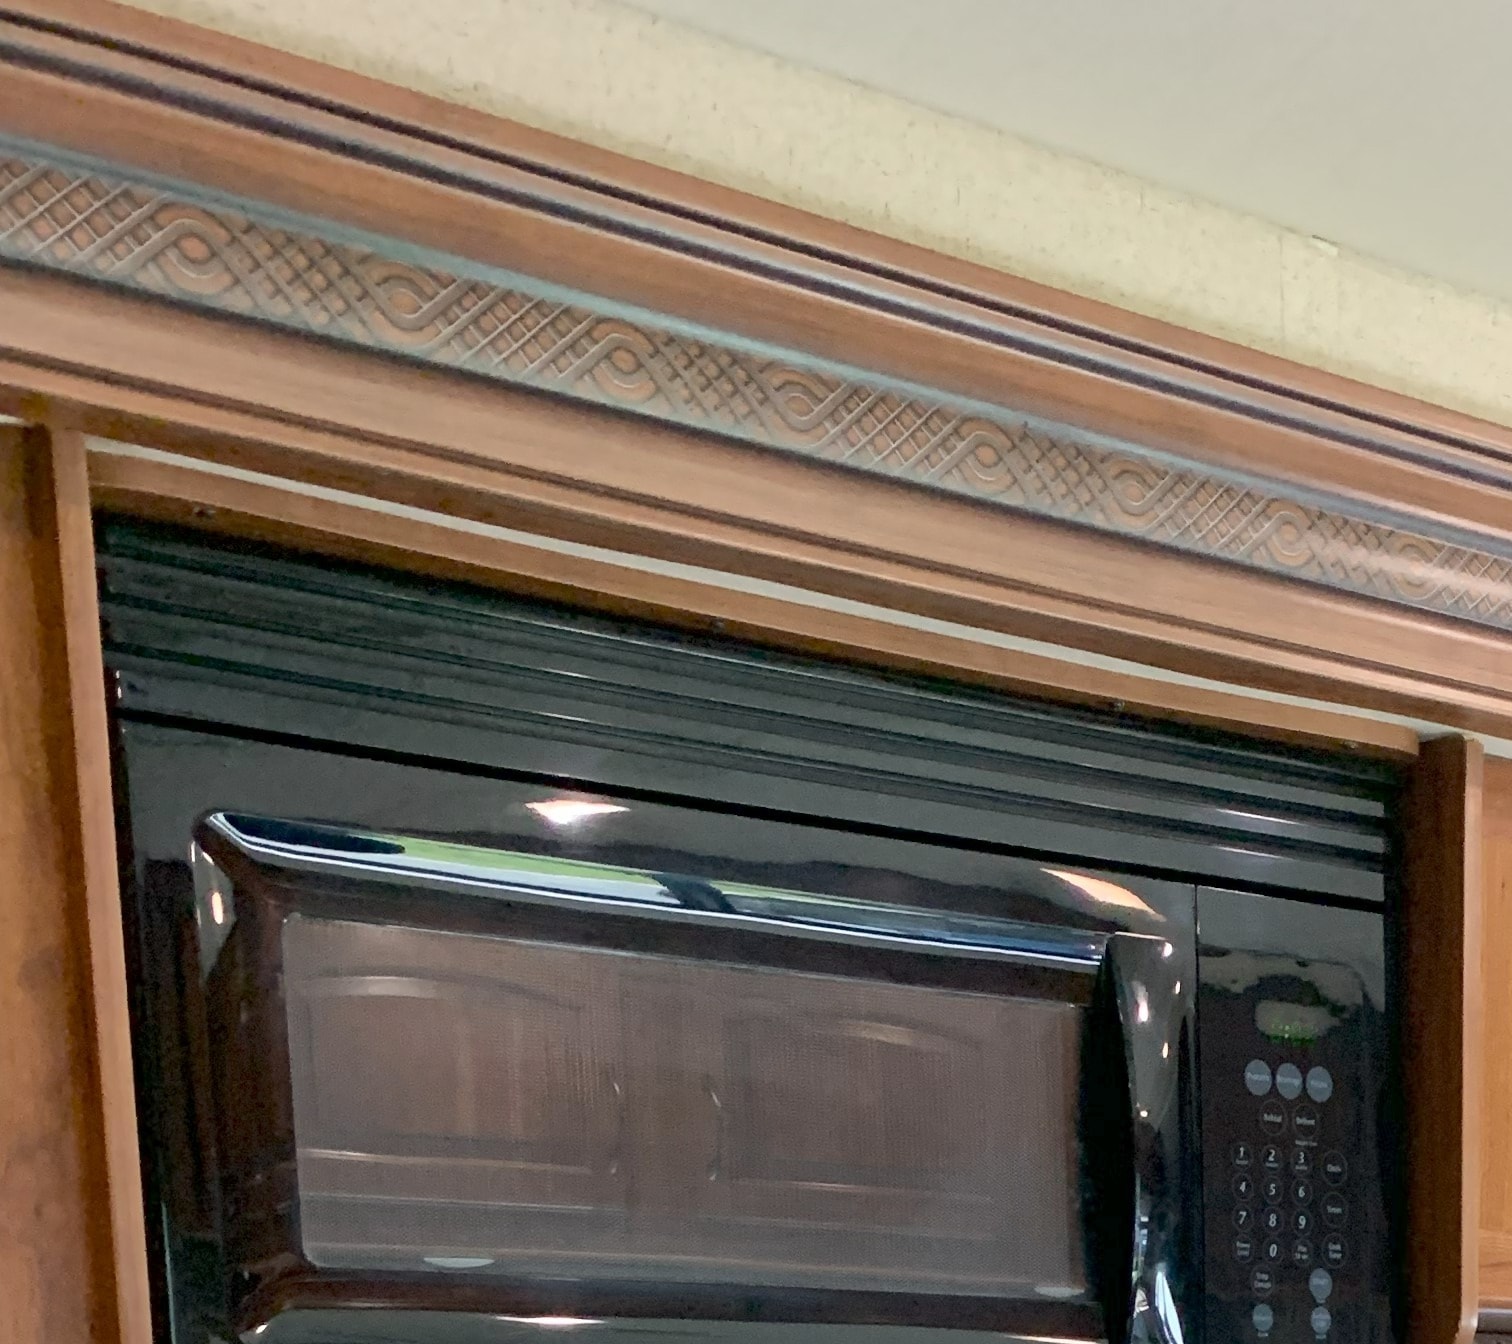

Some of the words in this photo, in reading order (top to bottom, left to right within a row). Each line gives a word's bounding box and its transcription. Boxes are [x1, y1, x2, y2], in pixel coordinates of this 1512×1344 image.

[1239, 1147, 1244, 1158] 1
[1268, 1150, 1275, 1161] 2
[1298, 1152, 1304, 1163] 3
[1239, 1181, 1246, 1193] 4
[1269, 1184, 1276, 1195] 5
[1298, 1186, 1305, 1198] 6
[1239, 1211, 1247, 1224] 7
[1269, 1213, 1277, 1227] 8
[1298, 1215, 1306, 1229] 9
[1269, 1243, 1278, 1258] 0
